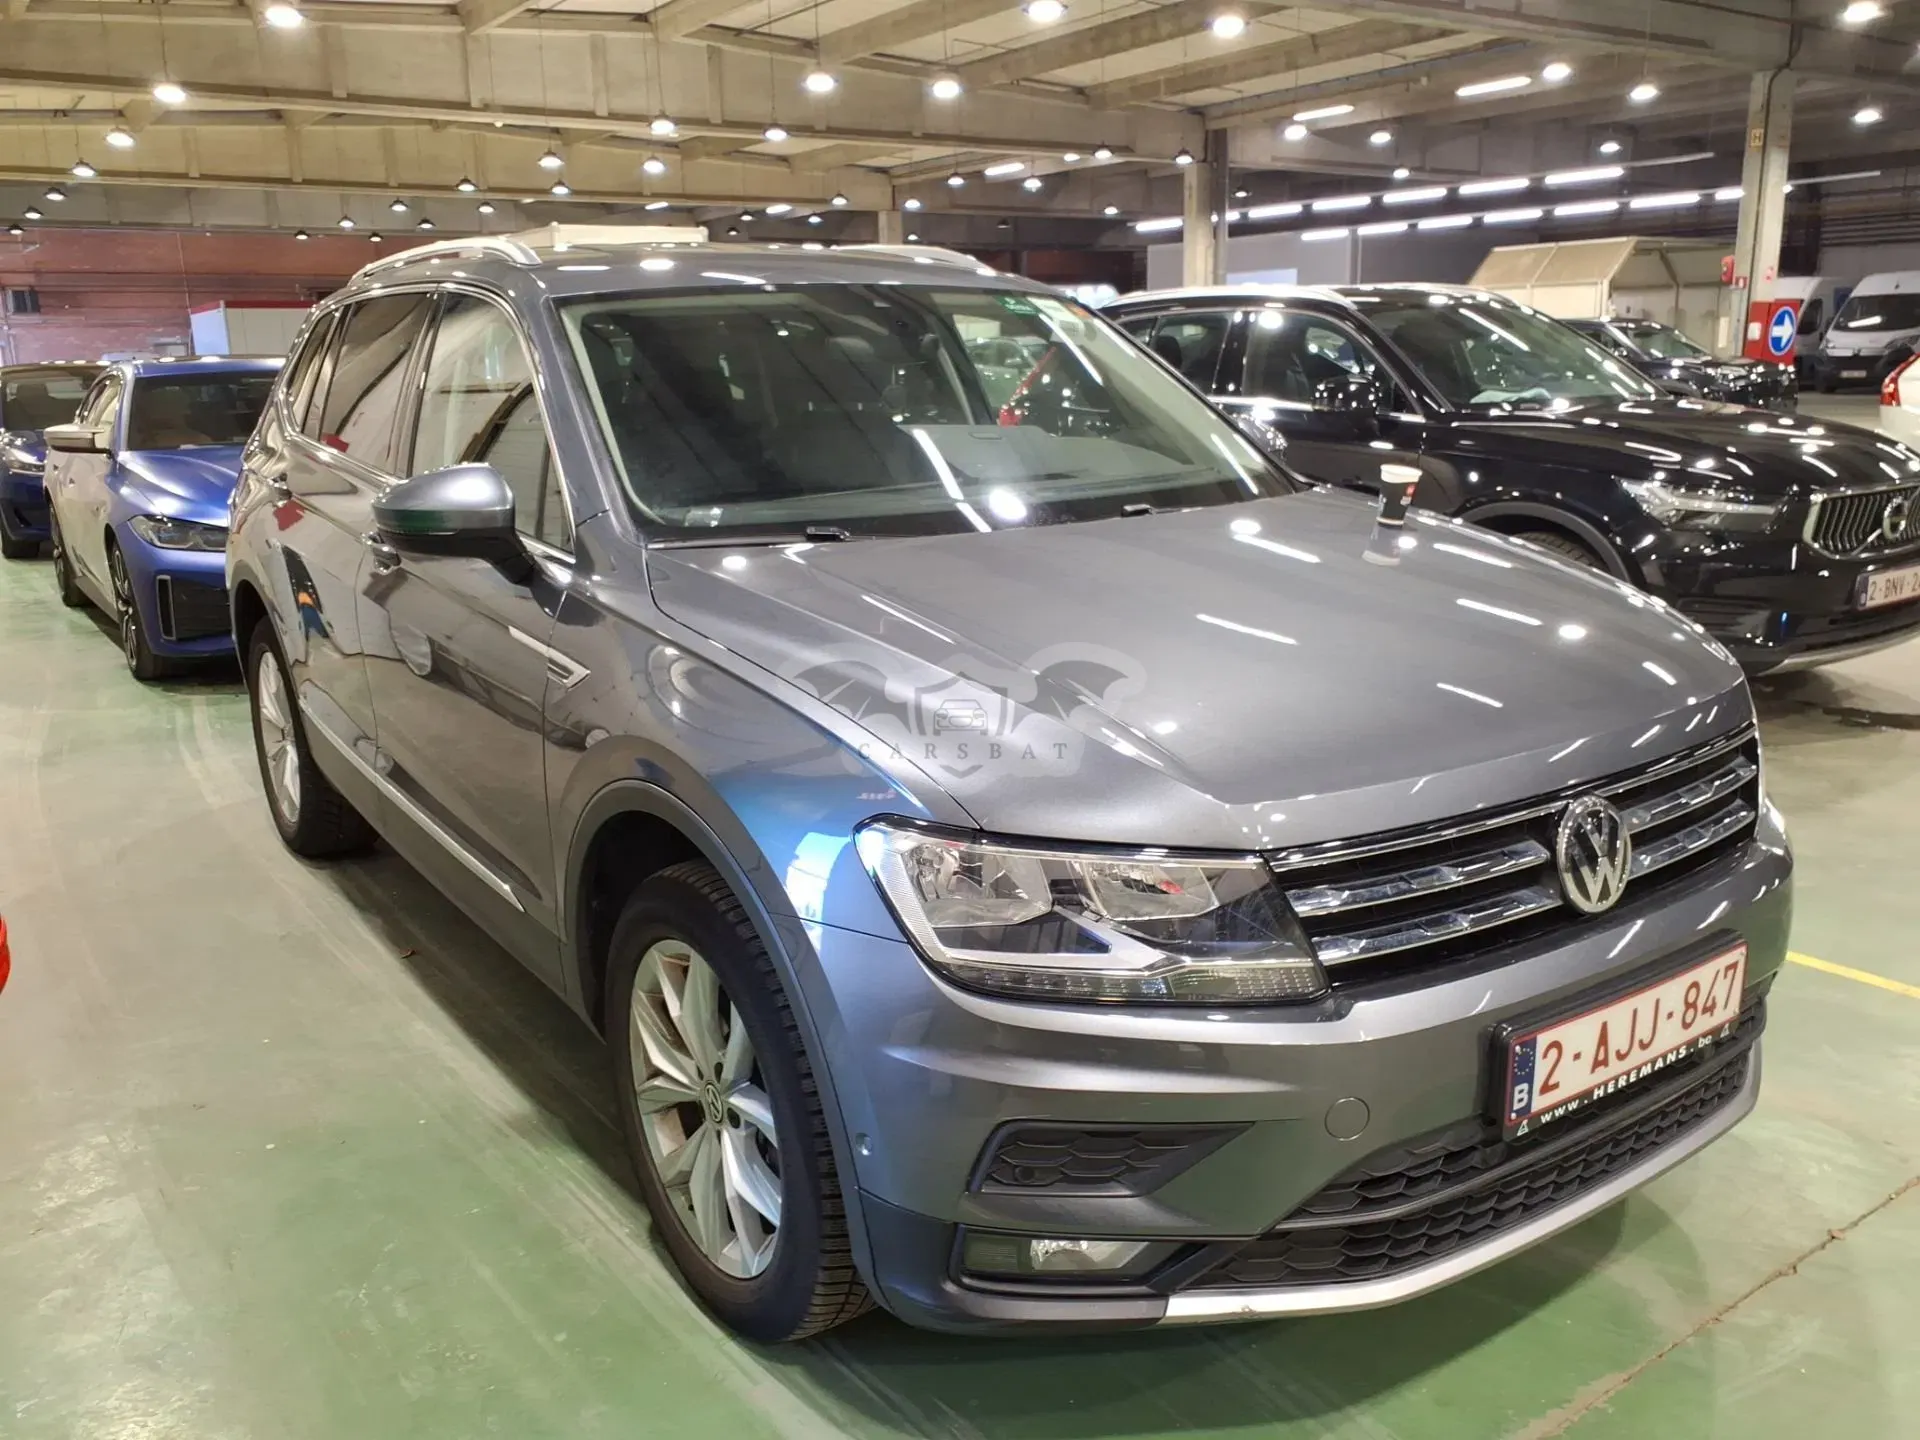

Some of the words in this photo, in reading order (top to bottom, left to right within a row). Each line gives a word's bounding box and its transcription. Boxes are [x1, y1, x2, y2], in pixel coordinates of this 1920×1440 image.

[1869, 571, 1920, 601] 2-BNV-2
[1538, 960, 1739, 1096] 2-AJJ-847
[1512, 1083, 1529, 1110] B
